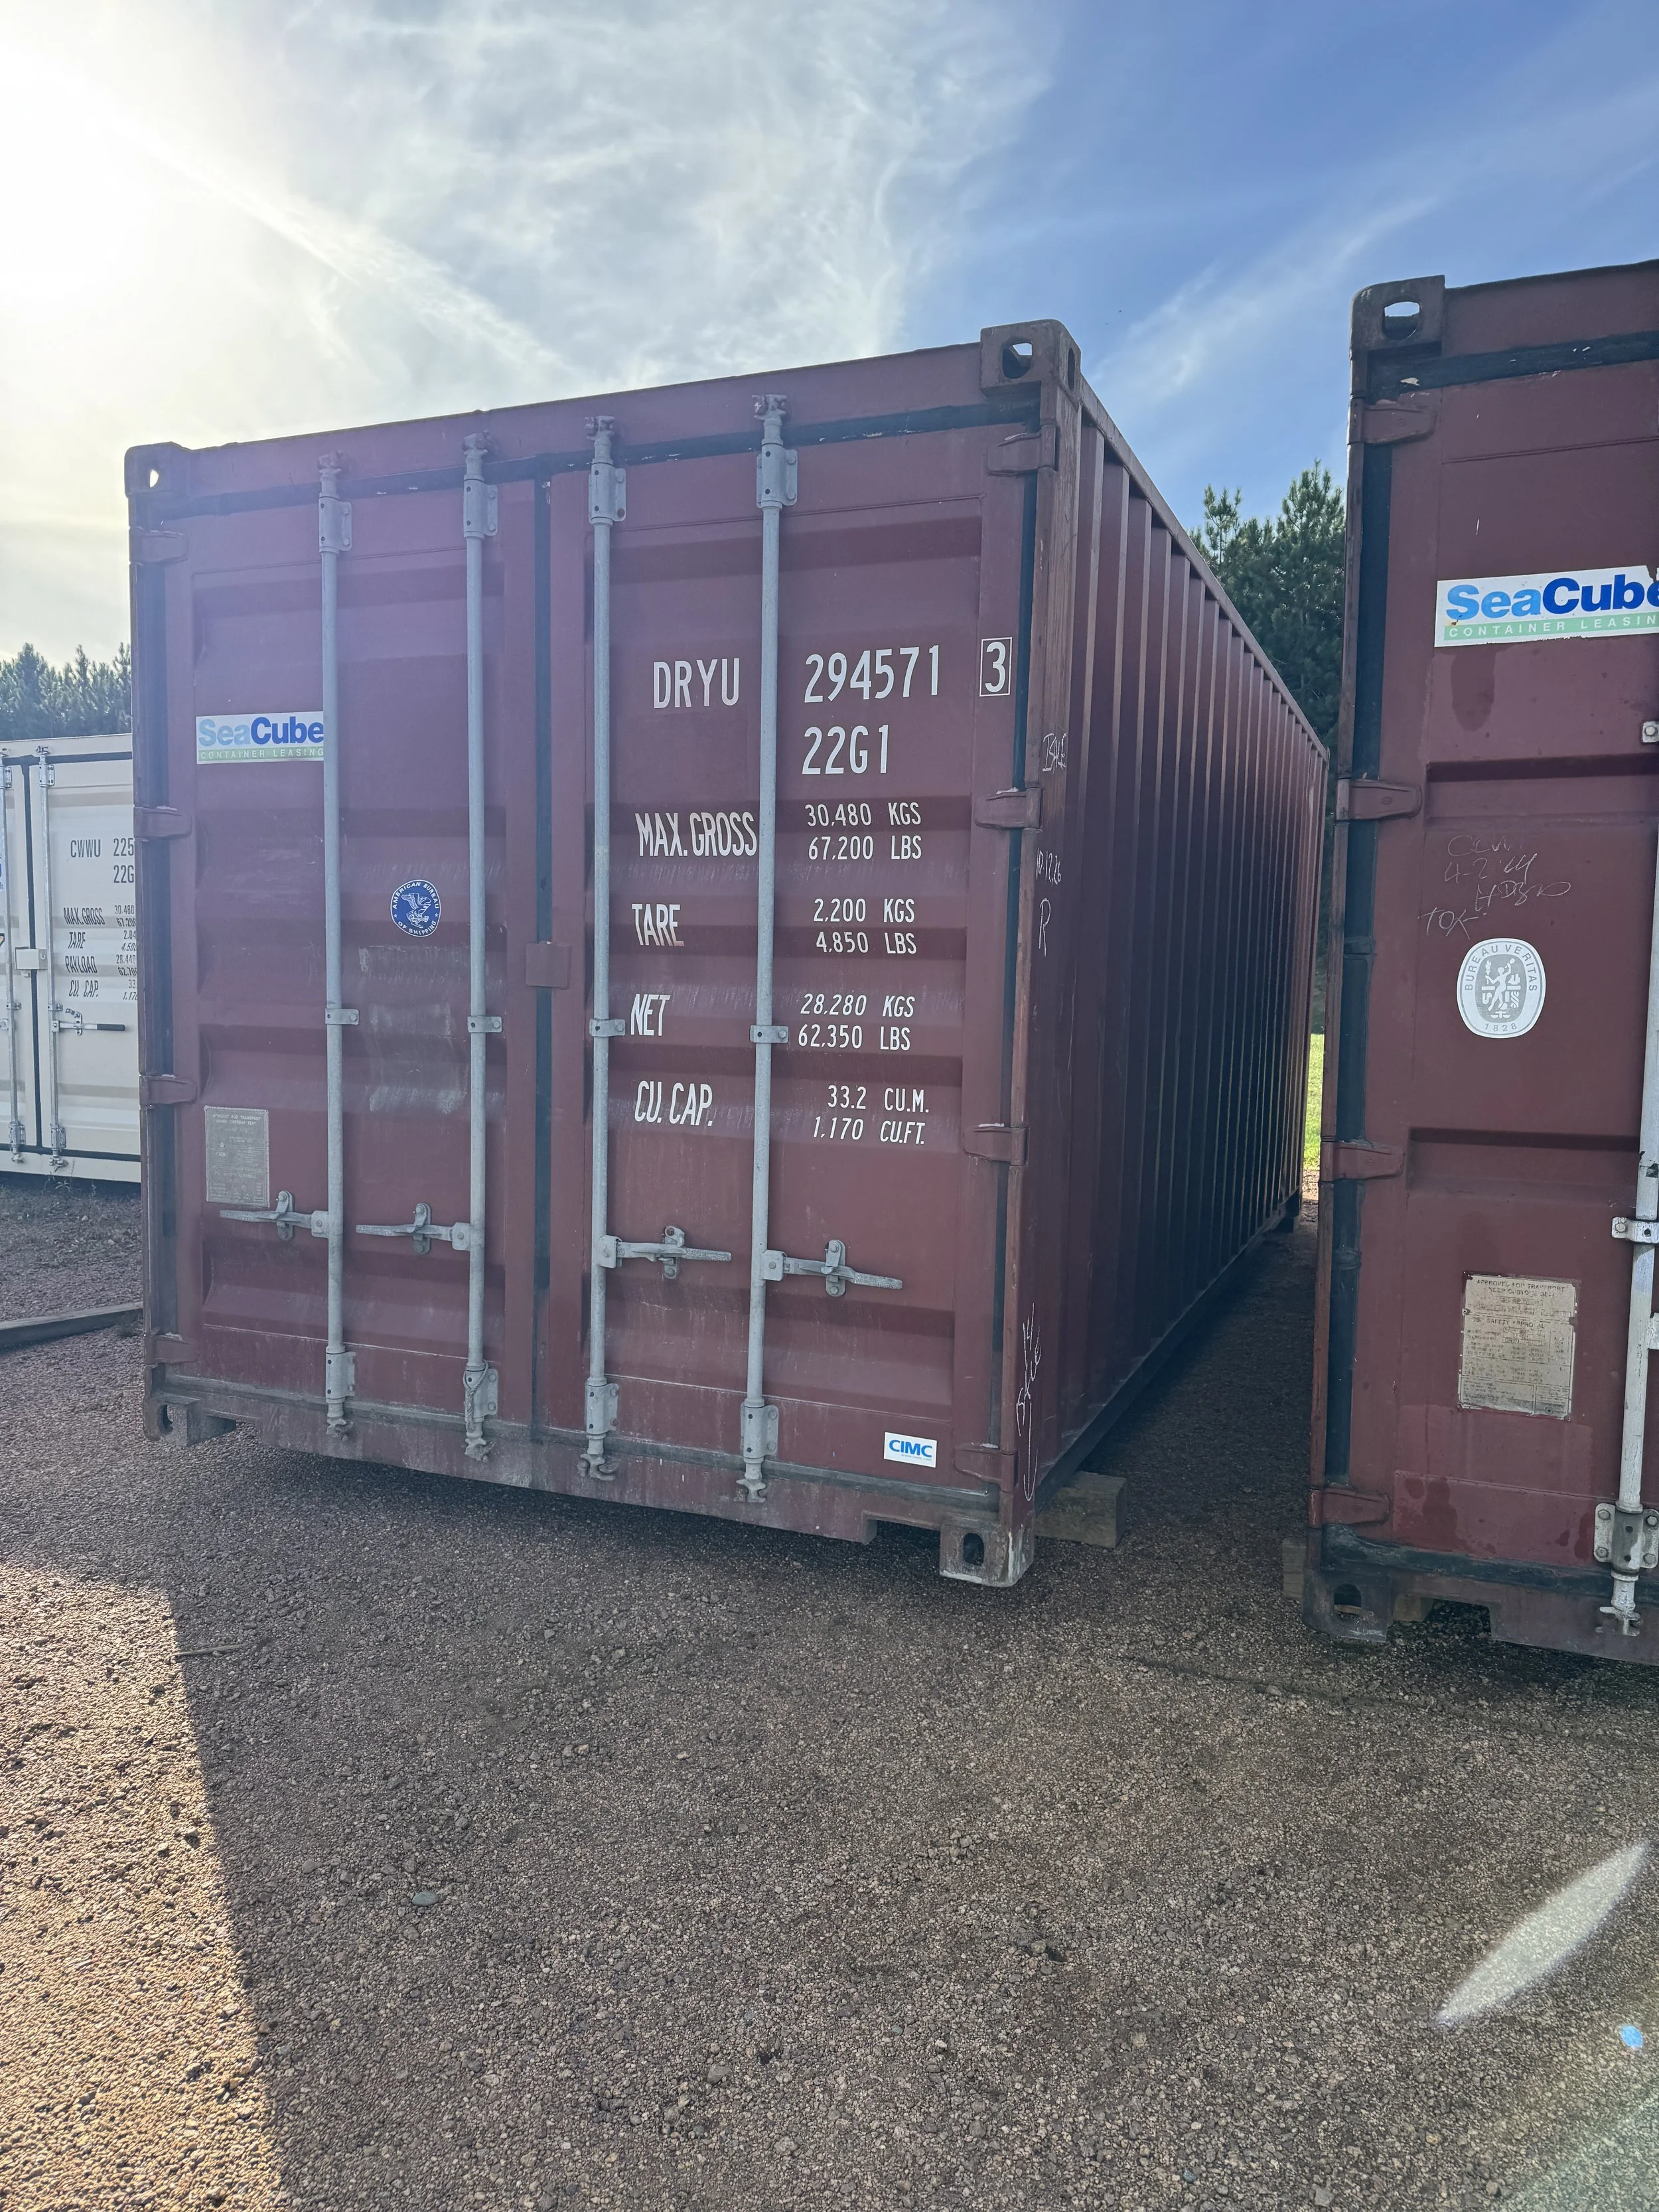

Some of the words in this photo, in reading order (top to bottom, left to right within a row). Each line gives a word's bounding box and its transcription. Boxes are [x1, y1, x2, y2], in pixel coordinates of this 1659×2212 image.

[1449, 621, 1565, 637] CONTAINER
[1581, 615, 1656, 630] LEASIN
[654, 658, 739, 708] DRYU
[804, 644, 939, 703] 294571
[985, 640, 1006, 693] 3
[198, 716, 324, 747] SeaCube
[200, 751, 265, 760] CONTAINER
[273, 748, 324, 757] LEASING
[802, 724, 889, 774] 22G1
[887, 802, 921, 826] KGS
[70, 839, 101, 858] CWWU
[113, 838, 134, 856] 225
[891, 835, 922, 859] LBS
[113, 865, 134, 883] 22G
[393, 881, 421, 909] AMERICAN
[423, 883, 439, 909] BUREAU
[409, 920, 437, 935] SHIPPING
[631, 903, 684, 946] TARE
[883, 898, 915, 923] KGS
[68, 932, 86, 949] TARE
[884, 932, 917, 954] LBS
[65, 956, 98, 974] PAYLOAD
[1465, 944, 1498, 991] BUREAU
[1505, 944, 1538, 992] VERITAS
[630, 994, 671, 1037] NET
[882, 995, 915, 1017] KGS
[1485, 1023, 1517, 1032] 1828
[880, 1026, 910, 1051] LBS
[828, 1084, 867, 1110] 33.2
[884, 1087, 929, 1113] CU.M.
[813, 1116, 864, 1140] 1,170
[880, 1120, 926, 1145] CU.FT.
[889, 1439, 933, 1458] CIMC
